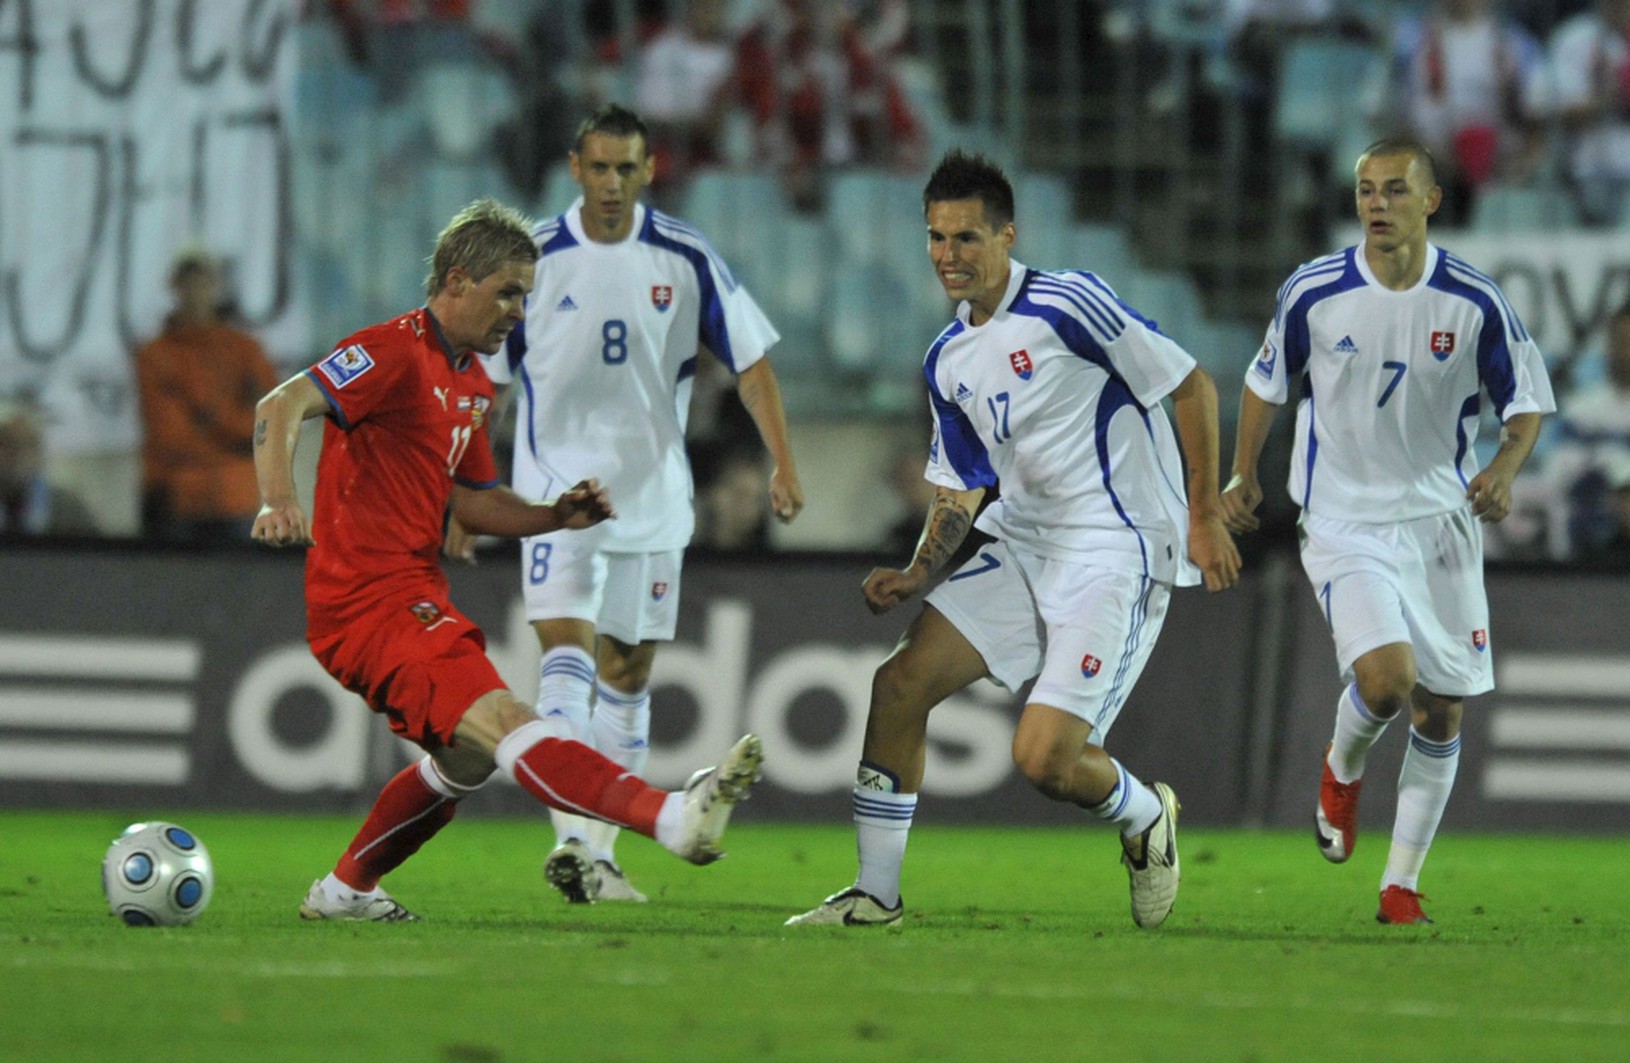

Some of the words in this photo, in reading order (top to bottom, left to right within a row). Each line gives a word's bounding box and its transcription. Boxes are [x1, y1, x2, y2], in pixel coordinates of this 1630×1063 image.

[602, 319, 627, 365] 8
[1377, 360, 1407, 409] 7
[987, 391, 1011, 444] 17
[447, 425, 472, 477] 11
[528, 542, 553, 586] 8
